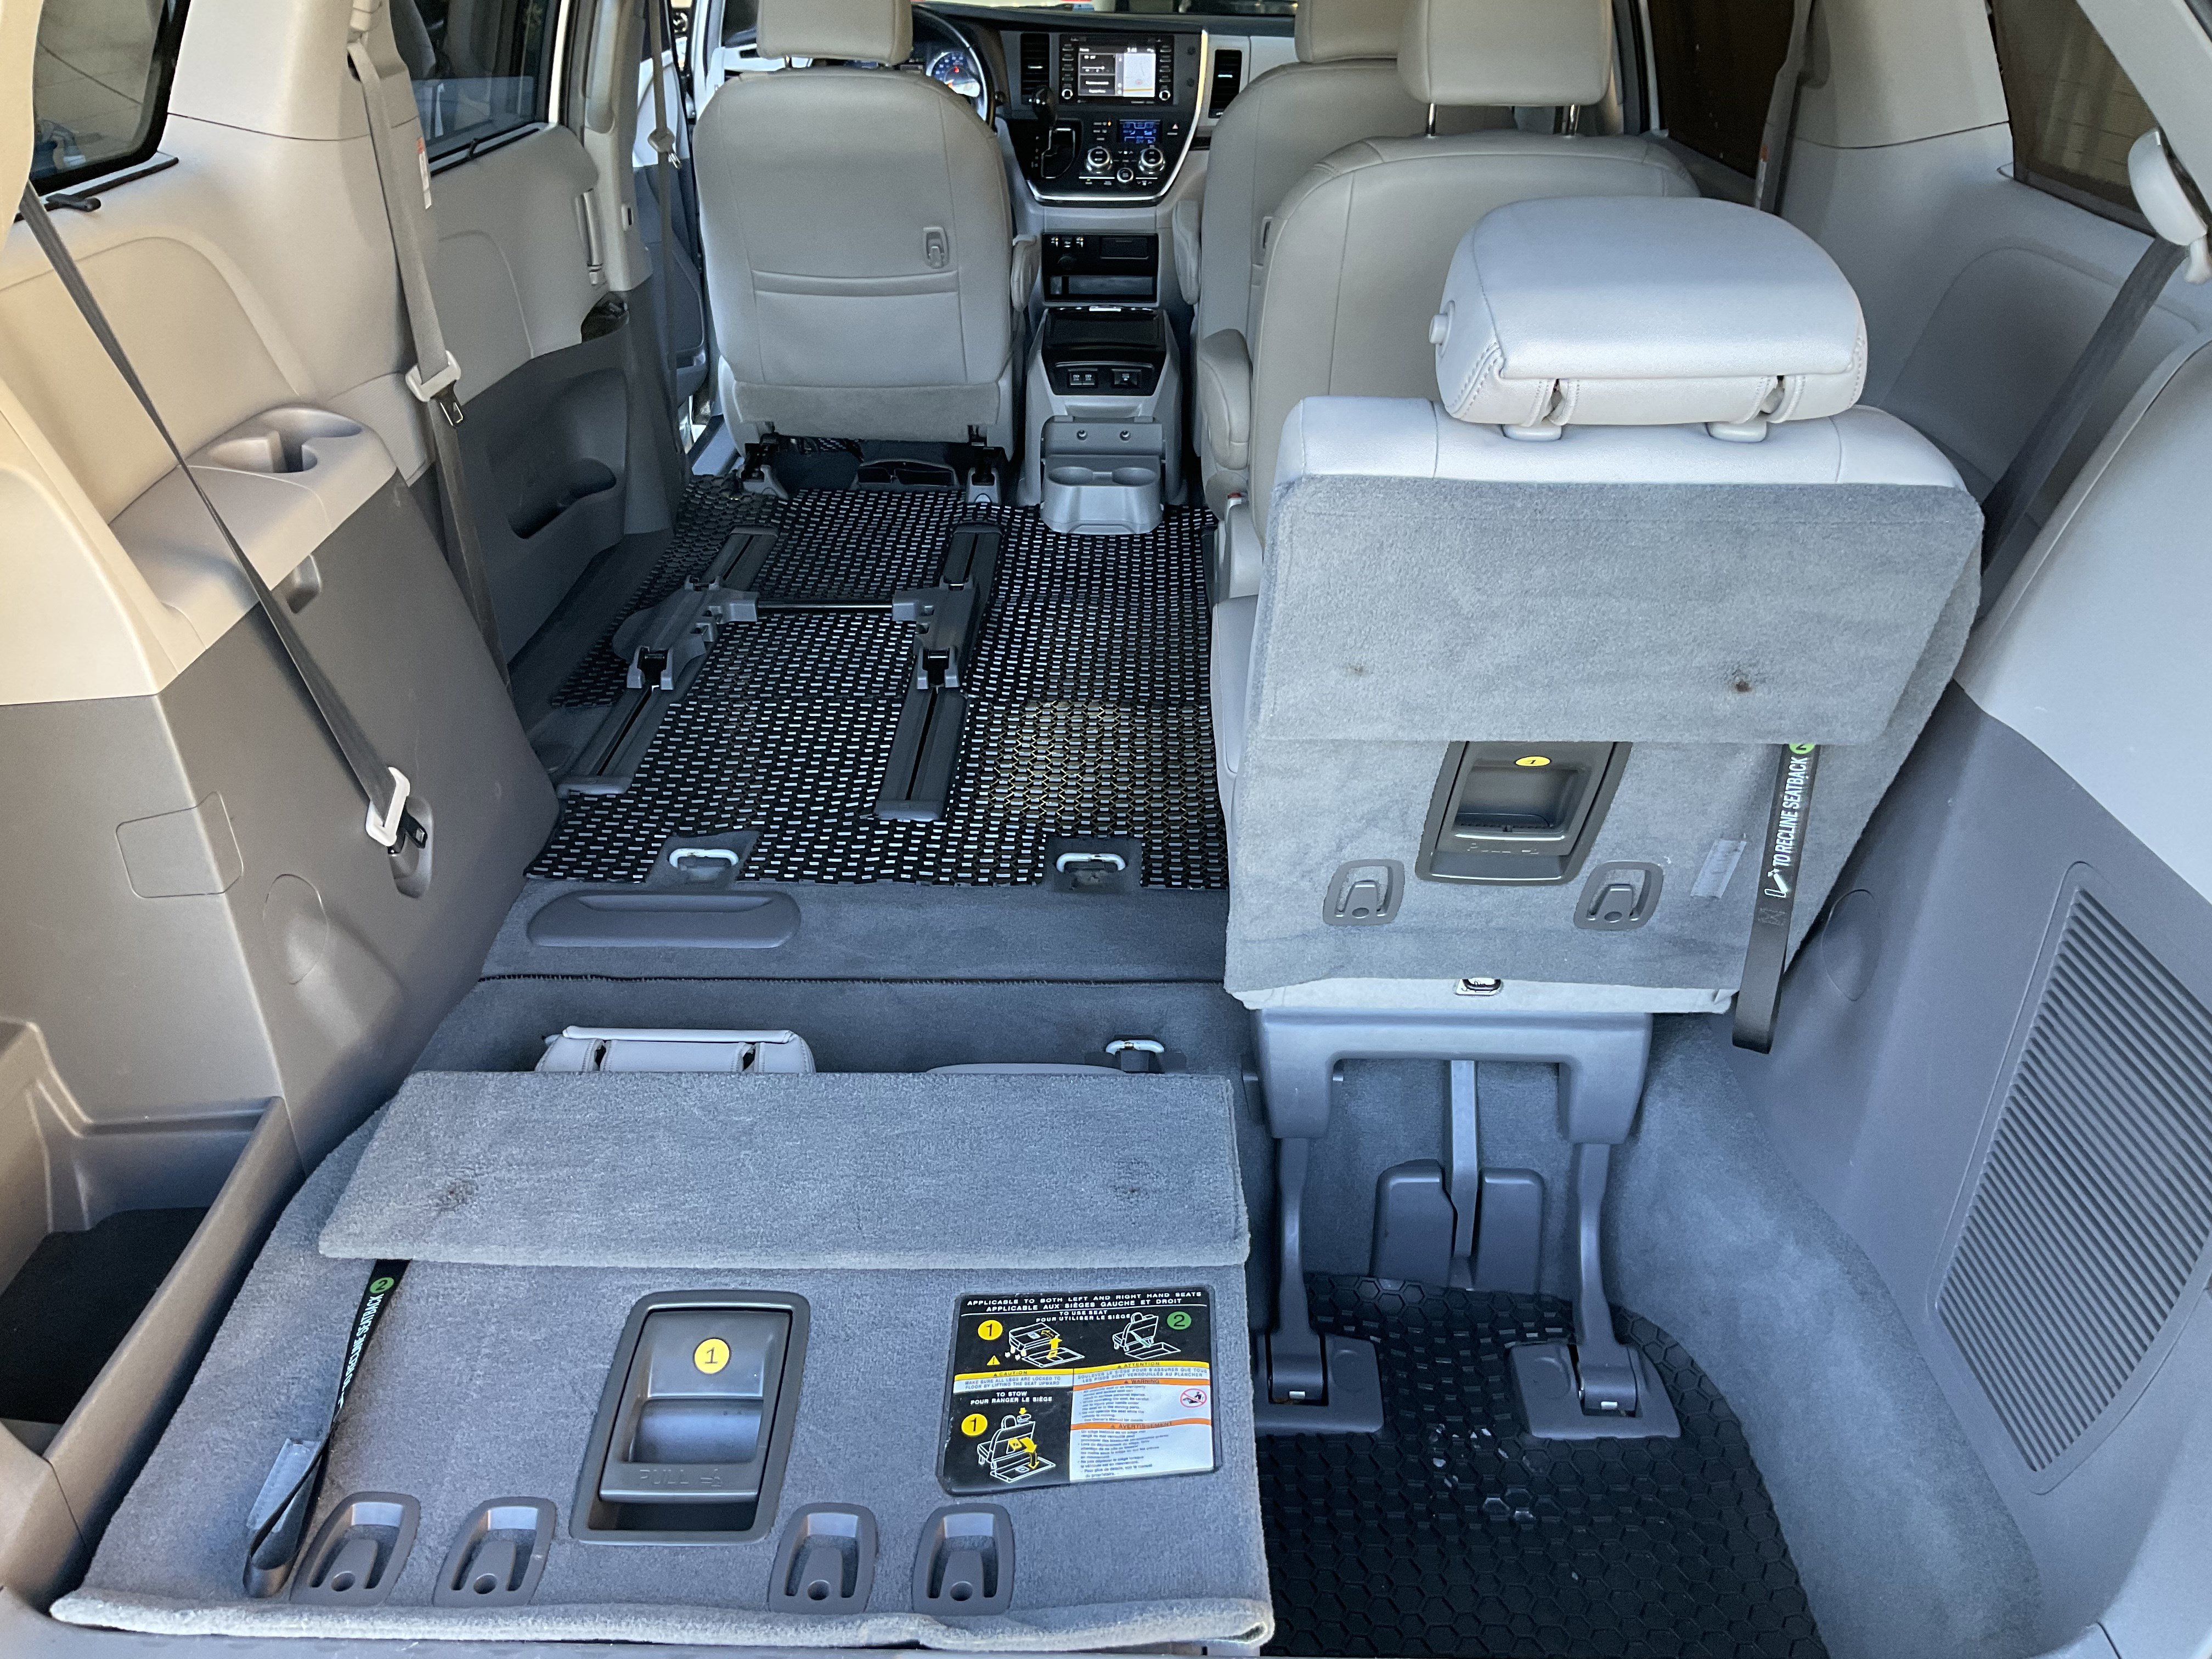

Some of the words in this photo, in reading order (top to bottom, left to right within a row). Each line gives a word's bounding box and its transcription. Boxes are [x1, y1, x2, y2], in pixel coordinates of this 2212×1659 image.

[1782, 756, 1808, 809] SEATBACK
[1775, 810, 1798, 854] RECLINE
[1772, 853, 1791, 867] TO
[375, 1280, 389, 1291] 2
[357, 1293, 384, 1336] SEATBACK
[1173, 1314, 1185, 1327] 2
[986, 1323, 993, 1336] 1
[704, 1346, 719, 1364] 1
[970, 1418, 977, 1432] 1
[1118, 1421, 1172, 1430] AVERTISSEMENT
